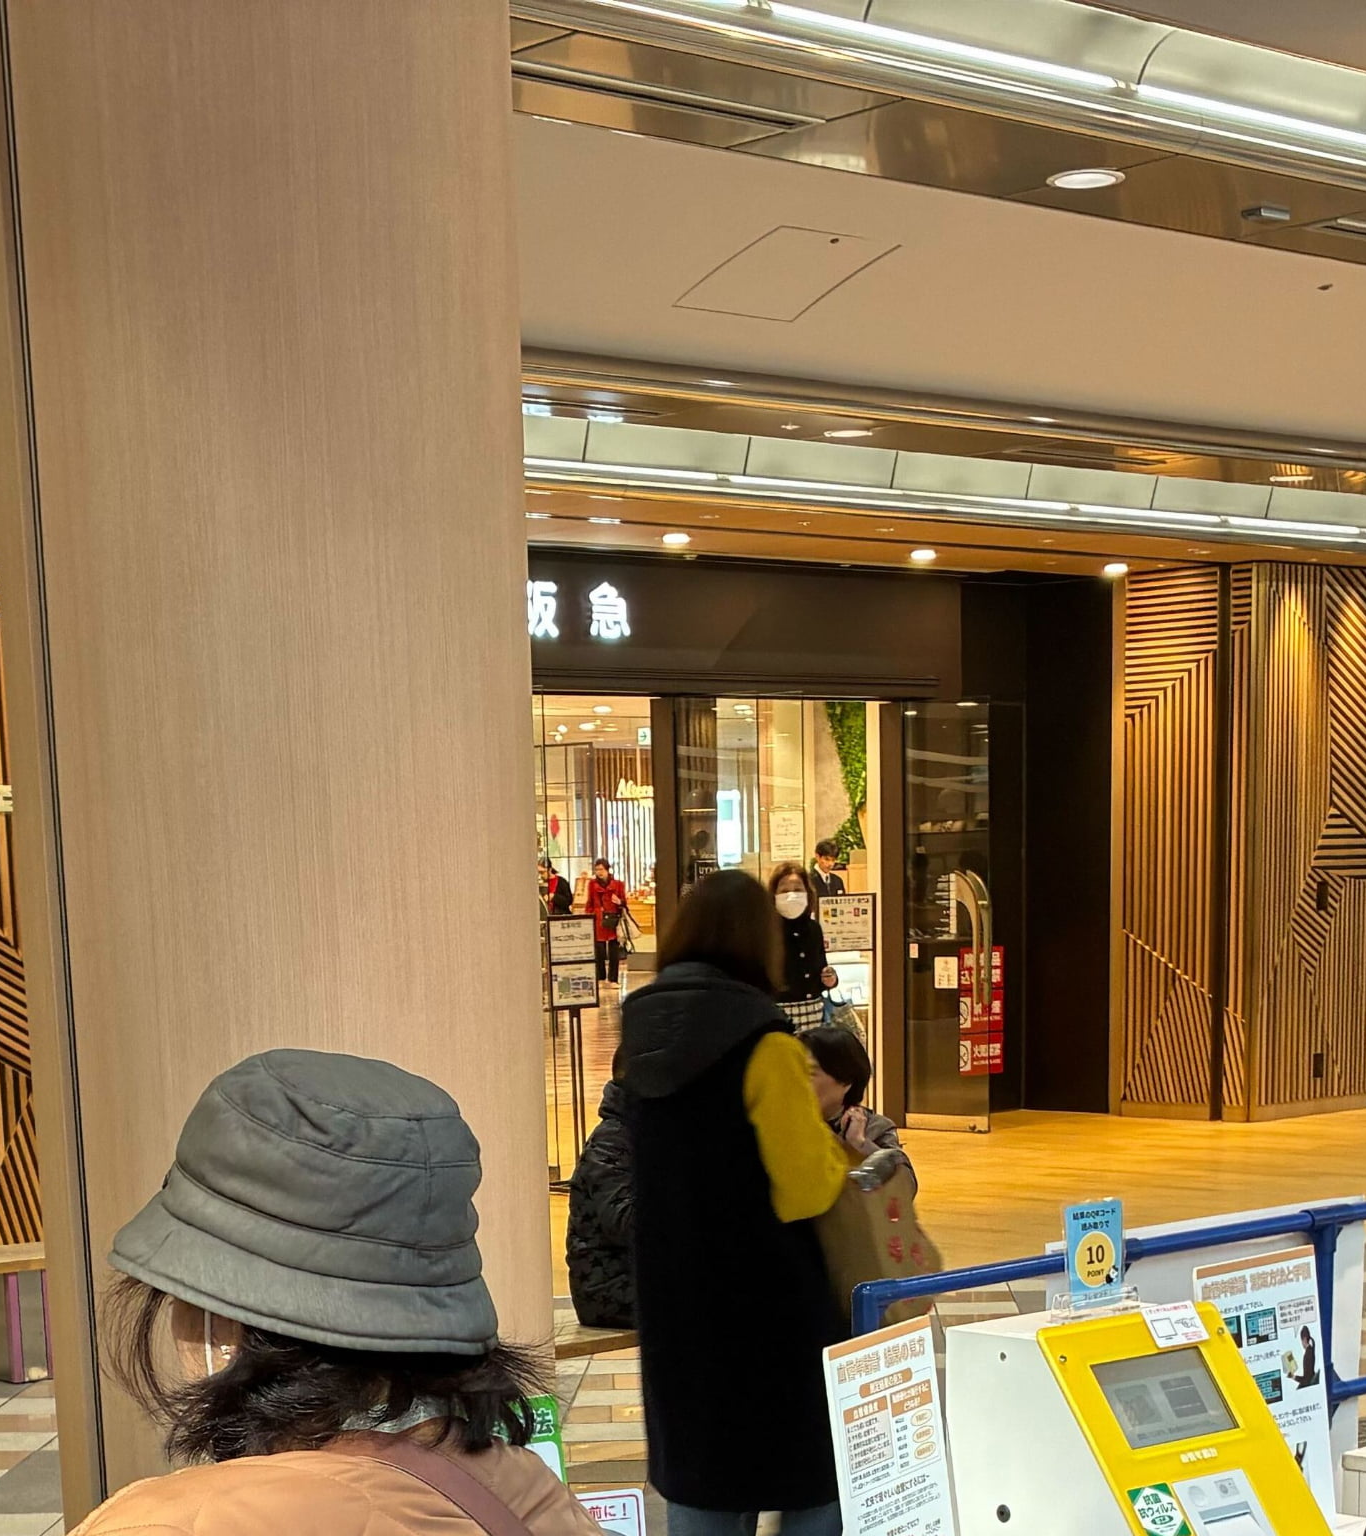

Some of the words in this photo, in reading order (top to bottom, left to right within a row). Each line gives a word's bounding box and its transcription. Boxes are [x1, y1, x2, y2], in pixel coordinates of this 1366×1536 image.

[1086, 1244, 1105, 1265] 10
[1087, 1269, 1105, 1278] POINT
[1137, 1502, 1177, 1519] 抗ウィルス
